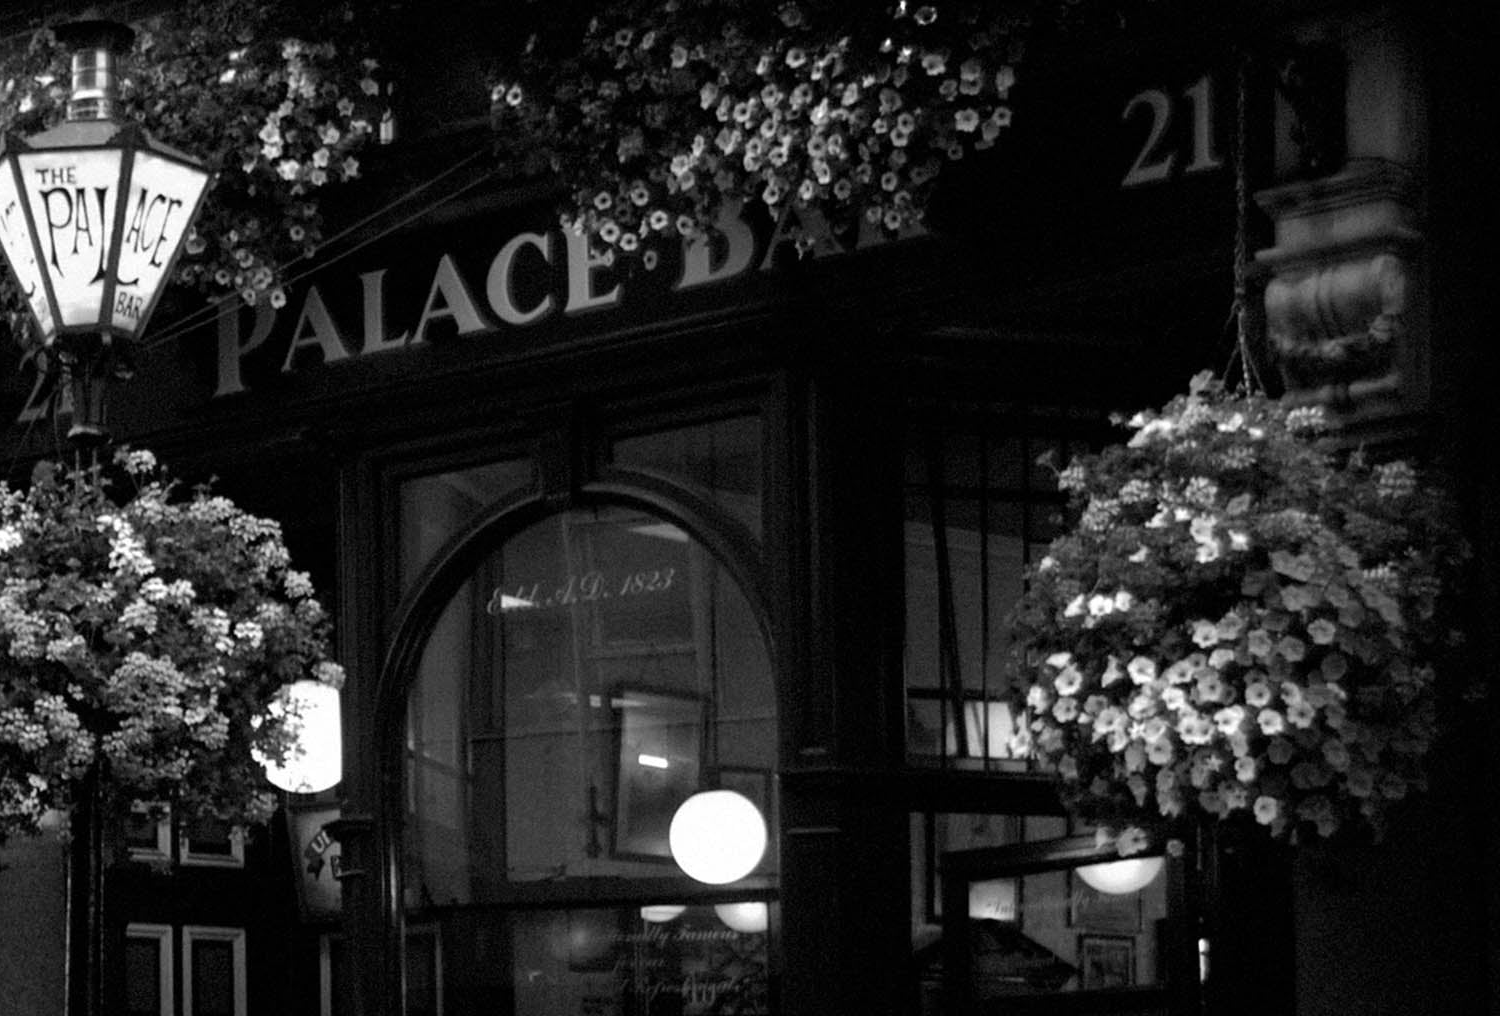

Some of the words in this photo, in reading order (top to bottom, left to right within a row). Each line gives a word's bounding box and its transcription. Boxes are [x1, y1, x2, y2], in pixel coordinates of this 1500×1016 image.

[35, 166, 78, 185] THE
[1120, 73, 1225, 190] 21
[38, 186, 184, 287] PALACE
[211, 224, 623, 399] PALACE
[620, 567, 676, 596] 1823
